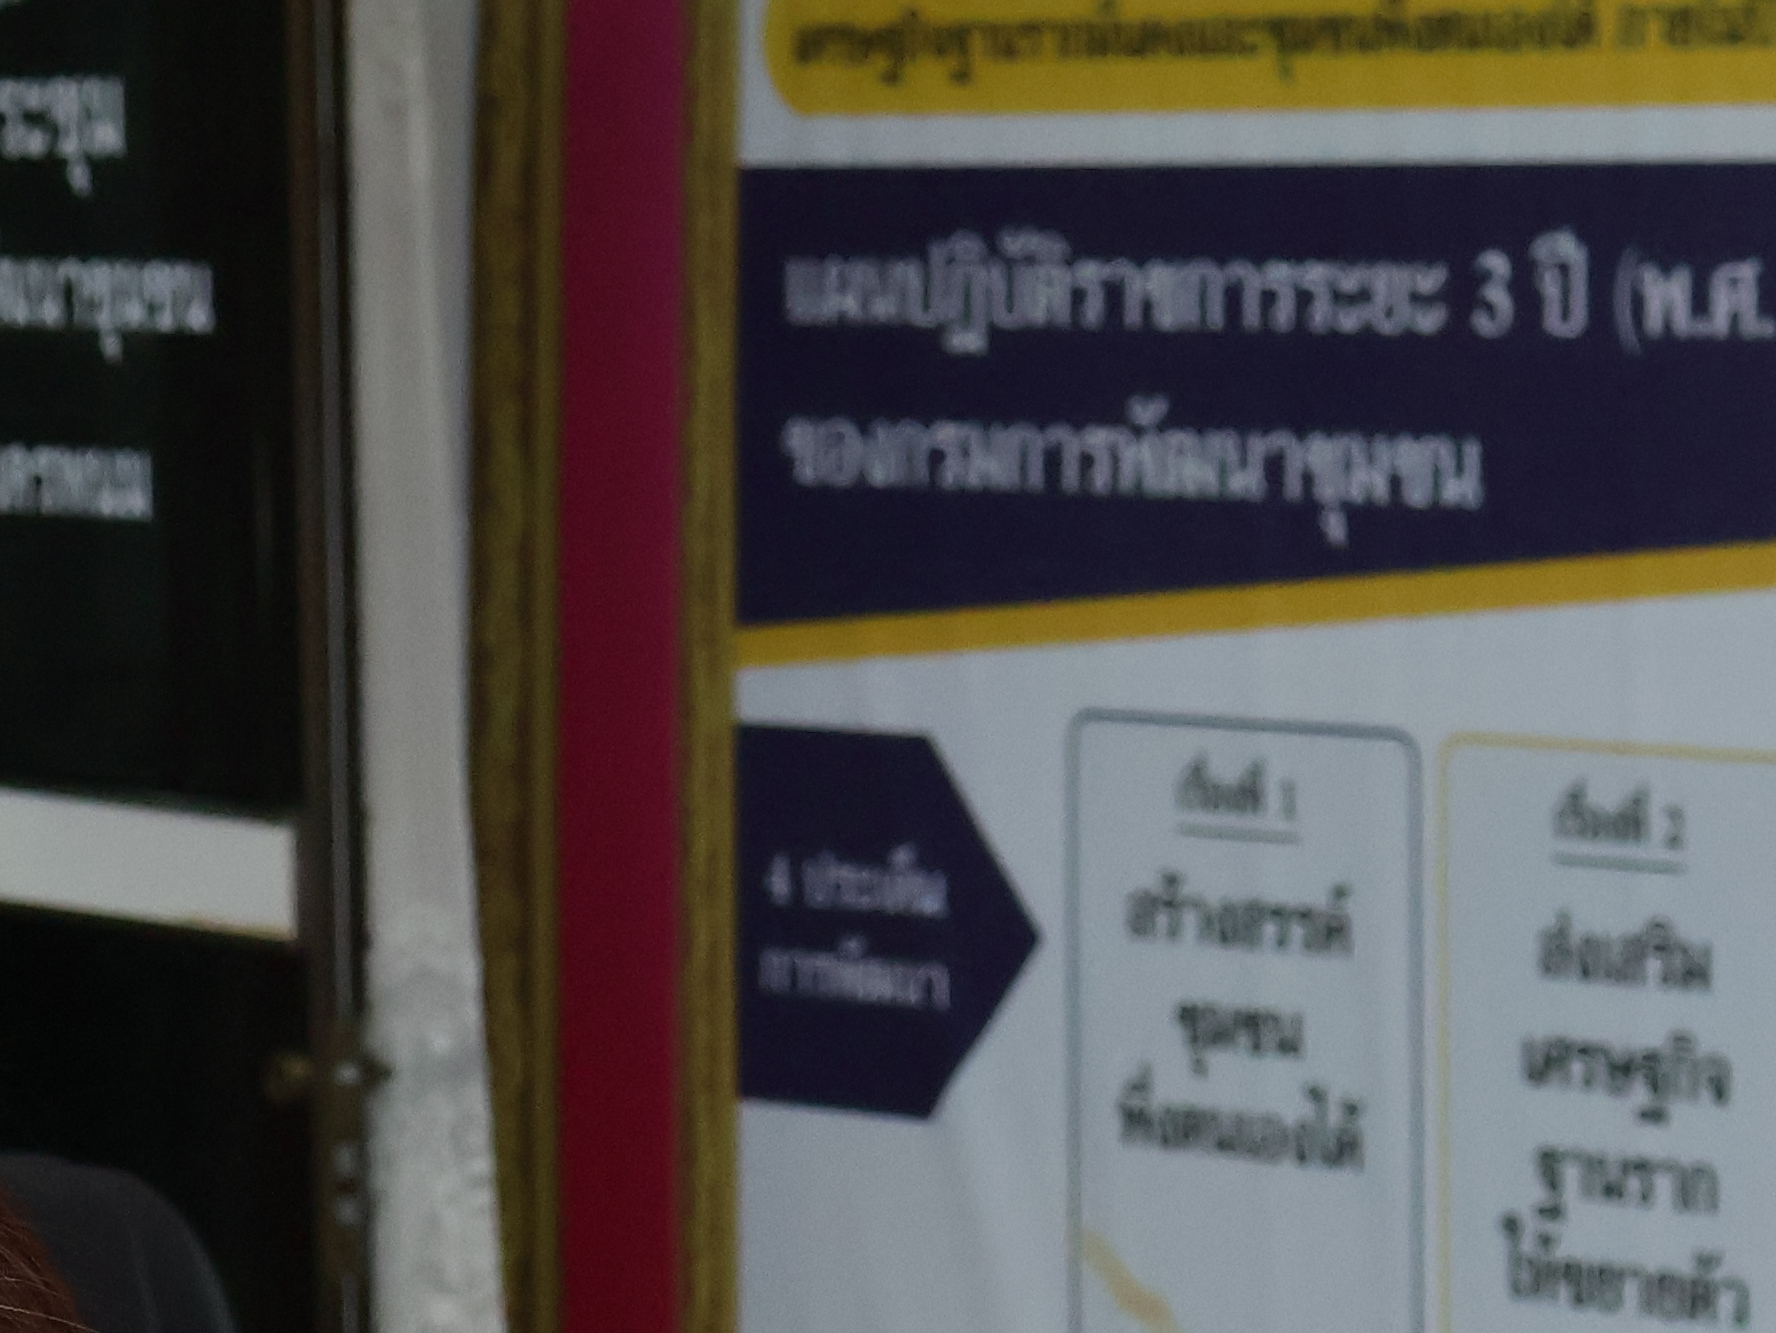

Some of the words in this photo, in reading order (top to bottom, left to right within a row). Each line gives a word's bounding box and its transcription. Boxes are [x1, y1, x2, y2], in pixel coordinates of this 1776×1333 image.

[784, 226, 1450, 354] แผนปฏิบัติราชการระยะ
[1470, 248, 1515, 339] 3
[1529, 226, 1588, 339] ปี
[780, 394, 1484, 548] ของกรมการพัฒนาชุมชน
[1537, 909, 1714, 993] ส่งเสริม
[1175, 1002, 1306, 1078] ชุมชน
